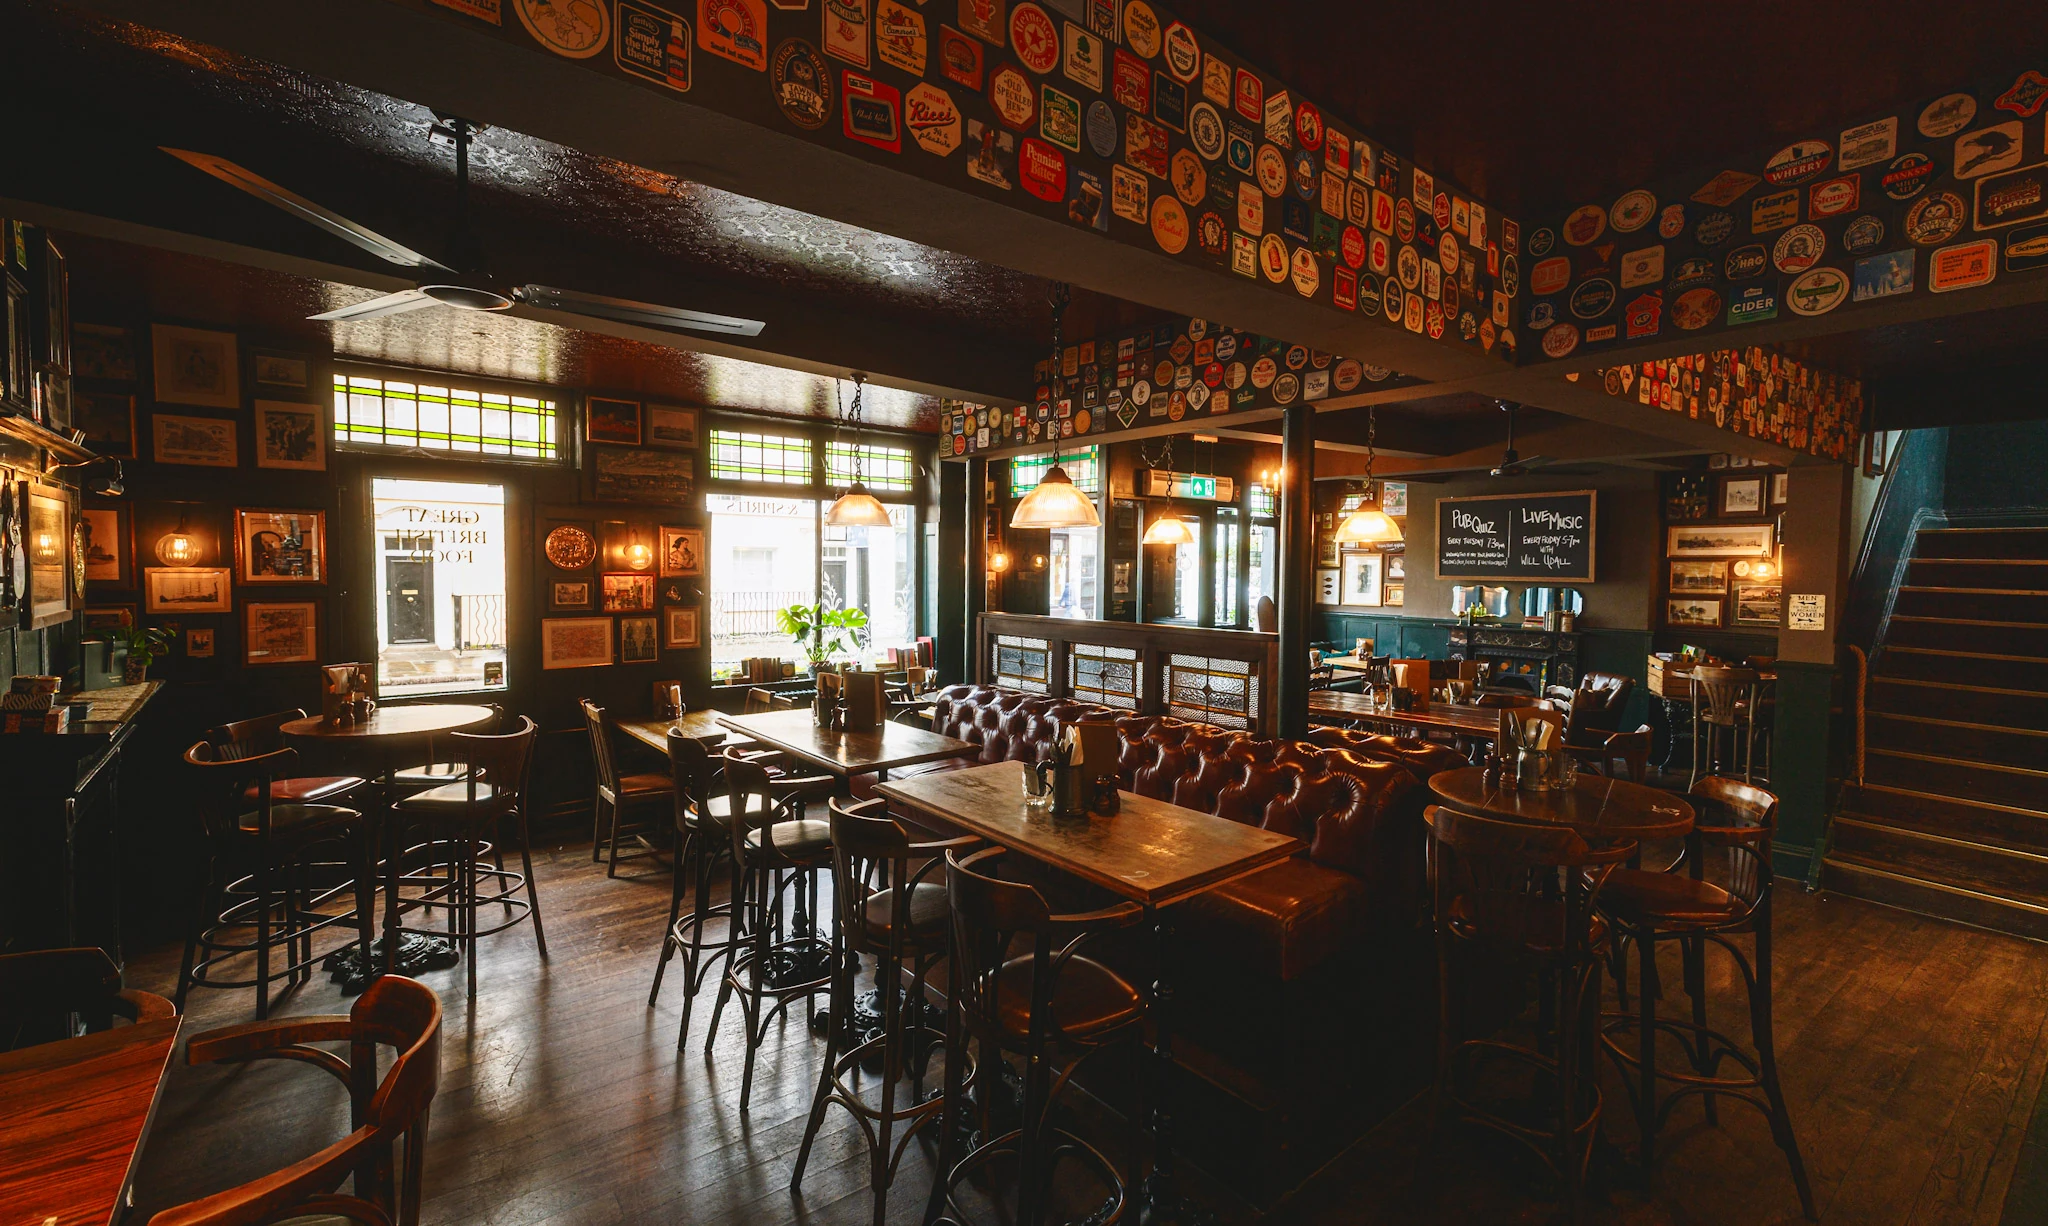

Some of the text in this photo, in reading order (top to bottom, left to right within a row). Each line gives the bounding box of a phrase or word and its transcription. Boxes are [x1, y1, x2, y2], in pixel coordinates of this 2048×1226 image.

[628, 27, 660, 47] Simply
[1015, 11, 1055, 48] Heineken
[625, 36, 662, 58] the best
[626, 47, 662, 67] there is
[1024, 49, 1047, 67] Bier
[788, 83, 817, 100] TAWNY
[789, 90, 818, 108] BITTER
[924, 91, 946, 105] DRINK
[996, 85, 1032, 107] SPECKLED
[909, 97, 956, 125] Ricci
[918, 130, 952, 149] pleasure
[1026, 143, 1062, 171] Pennine
[1031, 160, 1057, 183] Bitter
[1772, 160, 1823, 181] WHERRY
[1813, 189, 1855, 206] Stones
[1774, 232, 1793, 262] DOROTHY
[1731, 297, 1774, 314] CIDER
[1452, 509, 1472, 529] PUB
[1522, 508, 1549, 524] LIVE
[1541, 535, 1562, 548] FRIDAY
[1521, 553, 1540, 566] WILL
